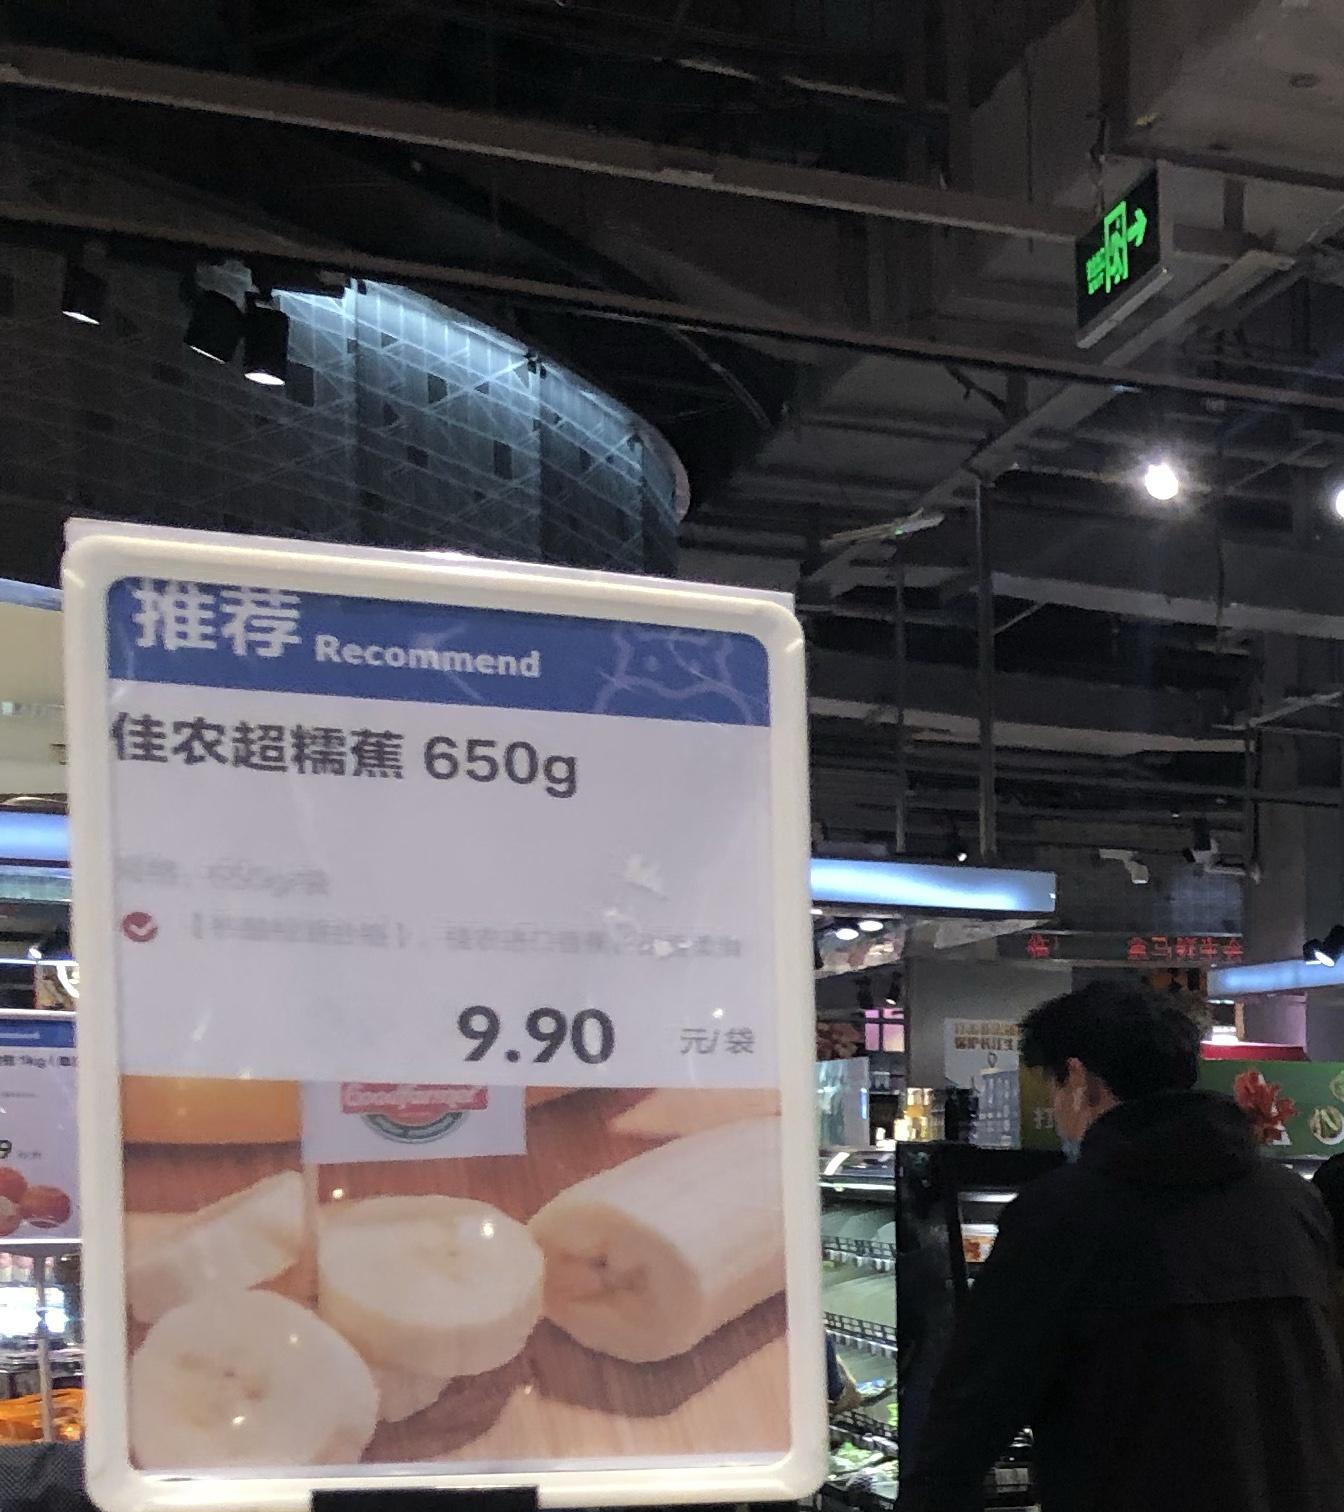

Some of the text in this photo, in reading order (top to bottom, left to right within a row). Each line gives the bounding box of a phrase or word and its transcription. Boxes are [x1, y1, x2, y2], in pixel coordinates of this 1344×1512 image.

[132, 577, 541, 678] 推荐 Recommend
[111, 711, 578, 799] 佳农超糯蕉 650g
[457, 1005, 755, 1064] 9.90 元/袋
